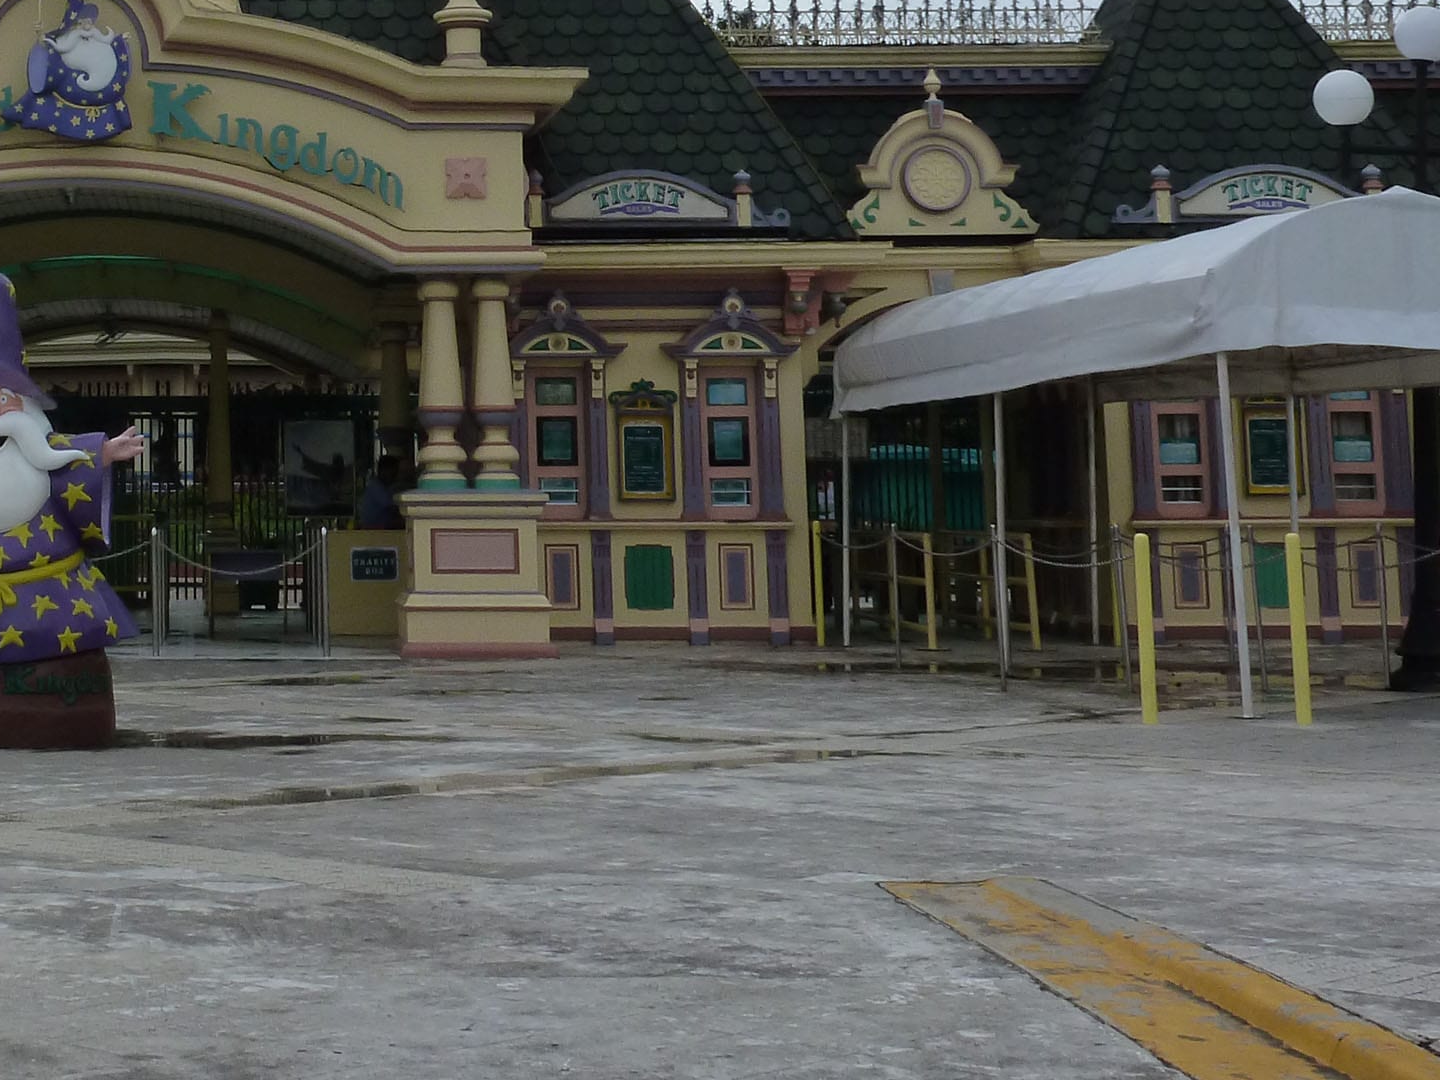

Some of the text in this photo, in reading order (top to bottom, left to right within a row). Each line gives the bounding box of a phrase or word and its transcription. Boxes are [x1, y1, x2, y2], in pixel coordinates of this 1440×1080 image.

[147, 80, 406, 211] Kingdom
[592, 182, 685, 210] TICKET
[1222, 175, 1313, 203] TICKET
